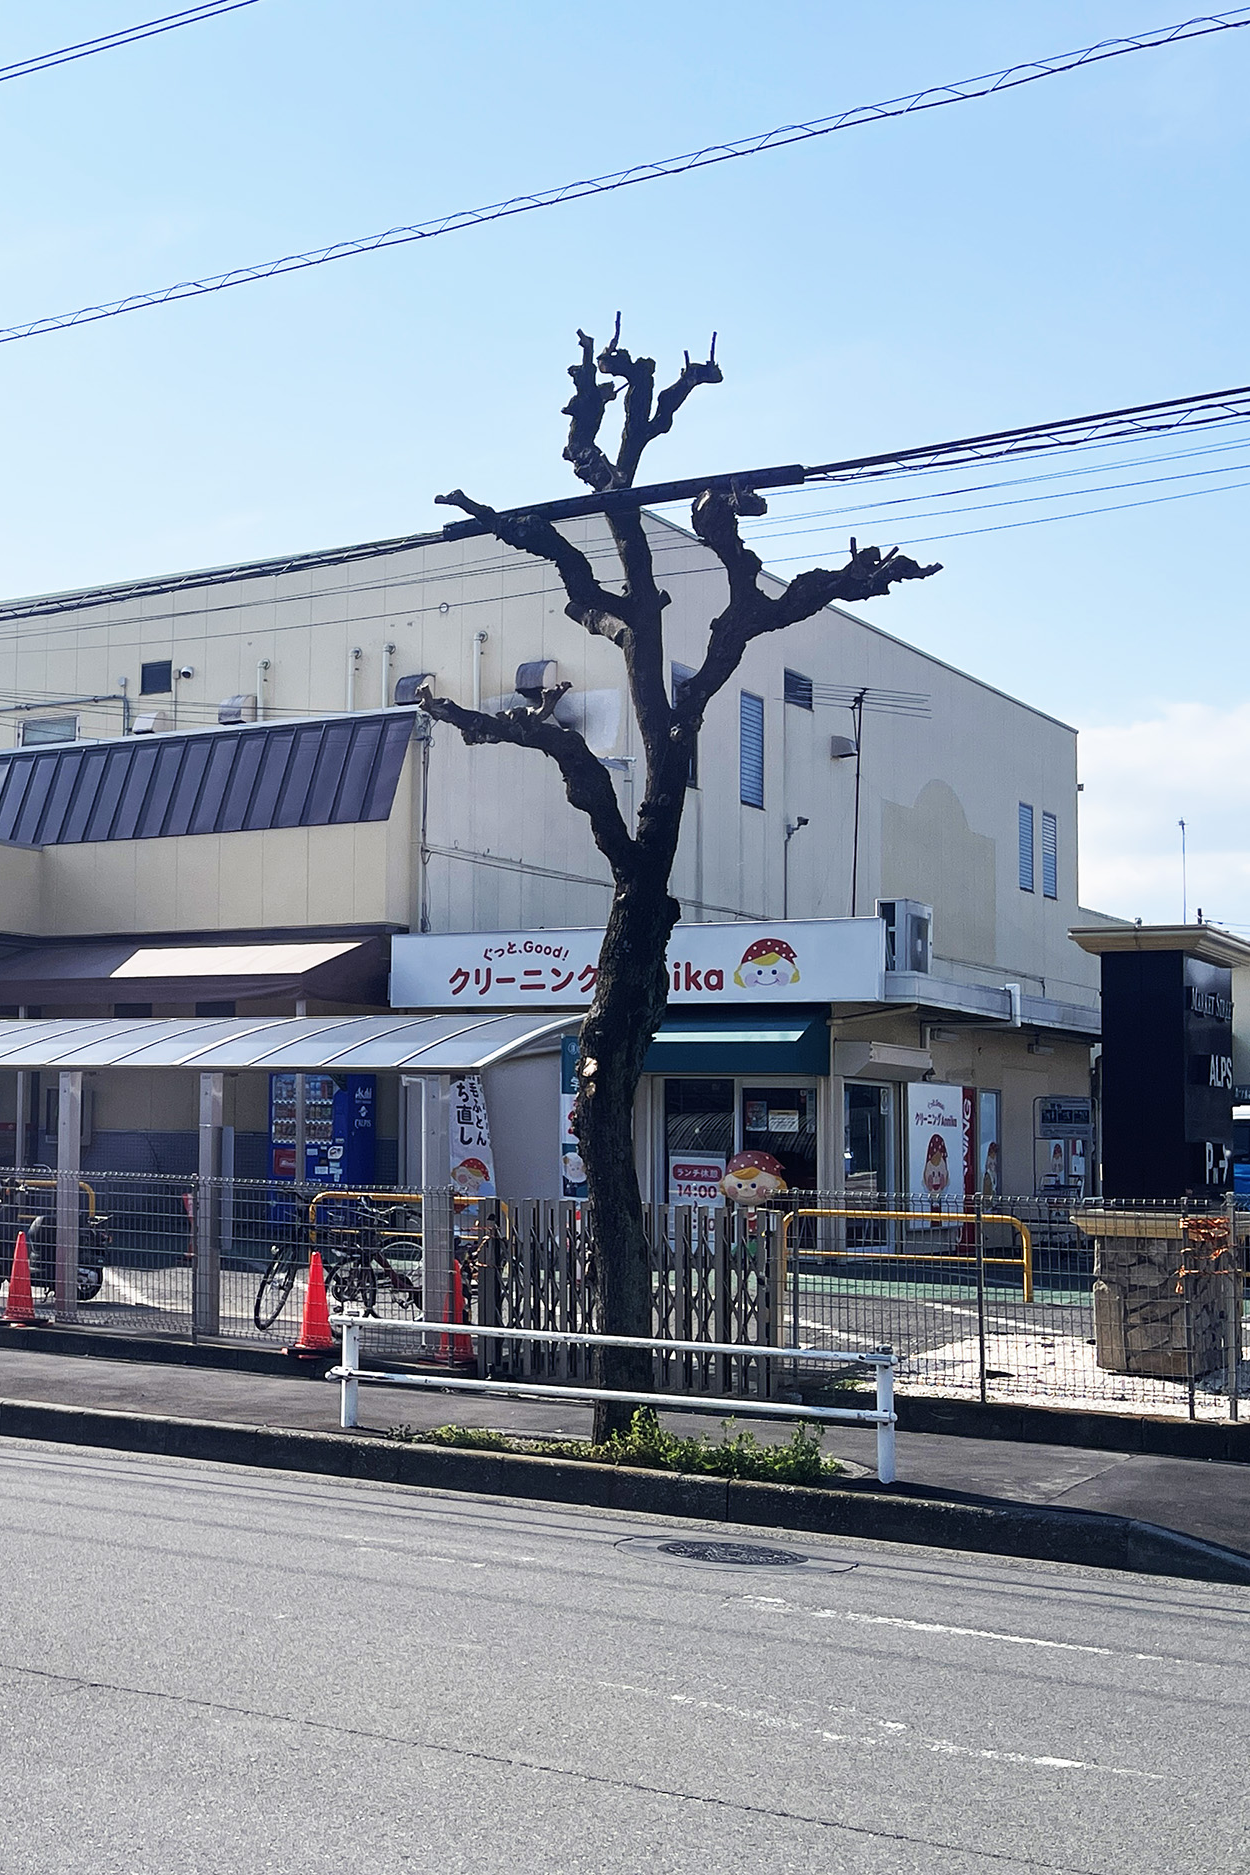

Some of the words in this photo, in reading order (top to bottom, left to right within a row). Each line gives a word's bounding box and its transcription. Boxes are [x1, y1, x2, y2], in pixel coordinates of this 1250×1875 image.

[672, 962, 724, 991] ika
[1209, 1054, 1233, 1090] ALPS
[676, 1183, 717, 1199] 14:00
